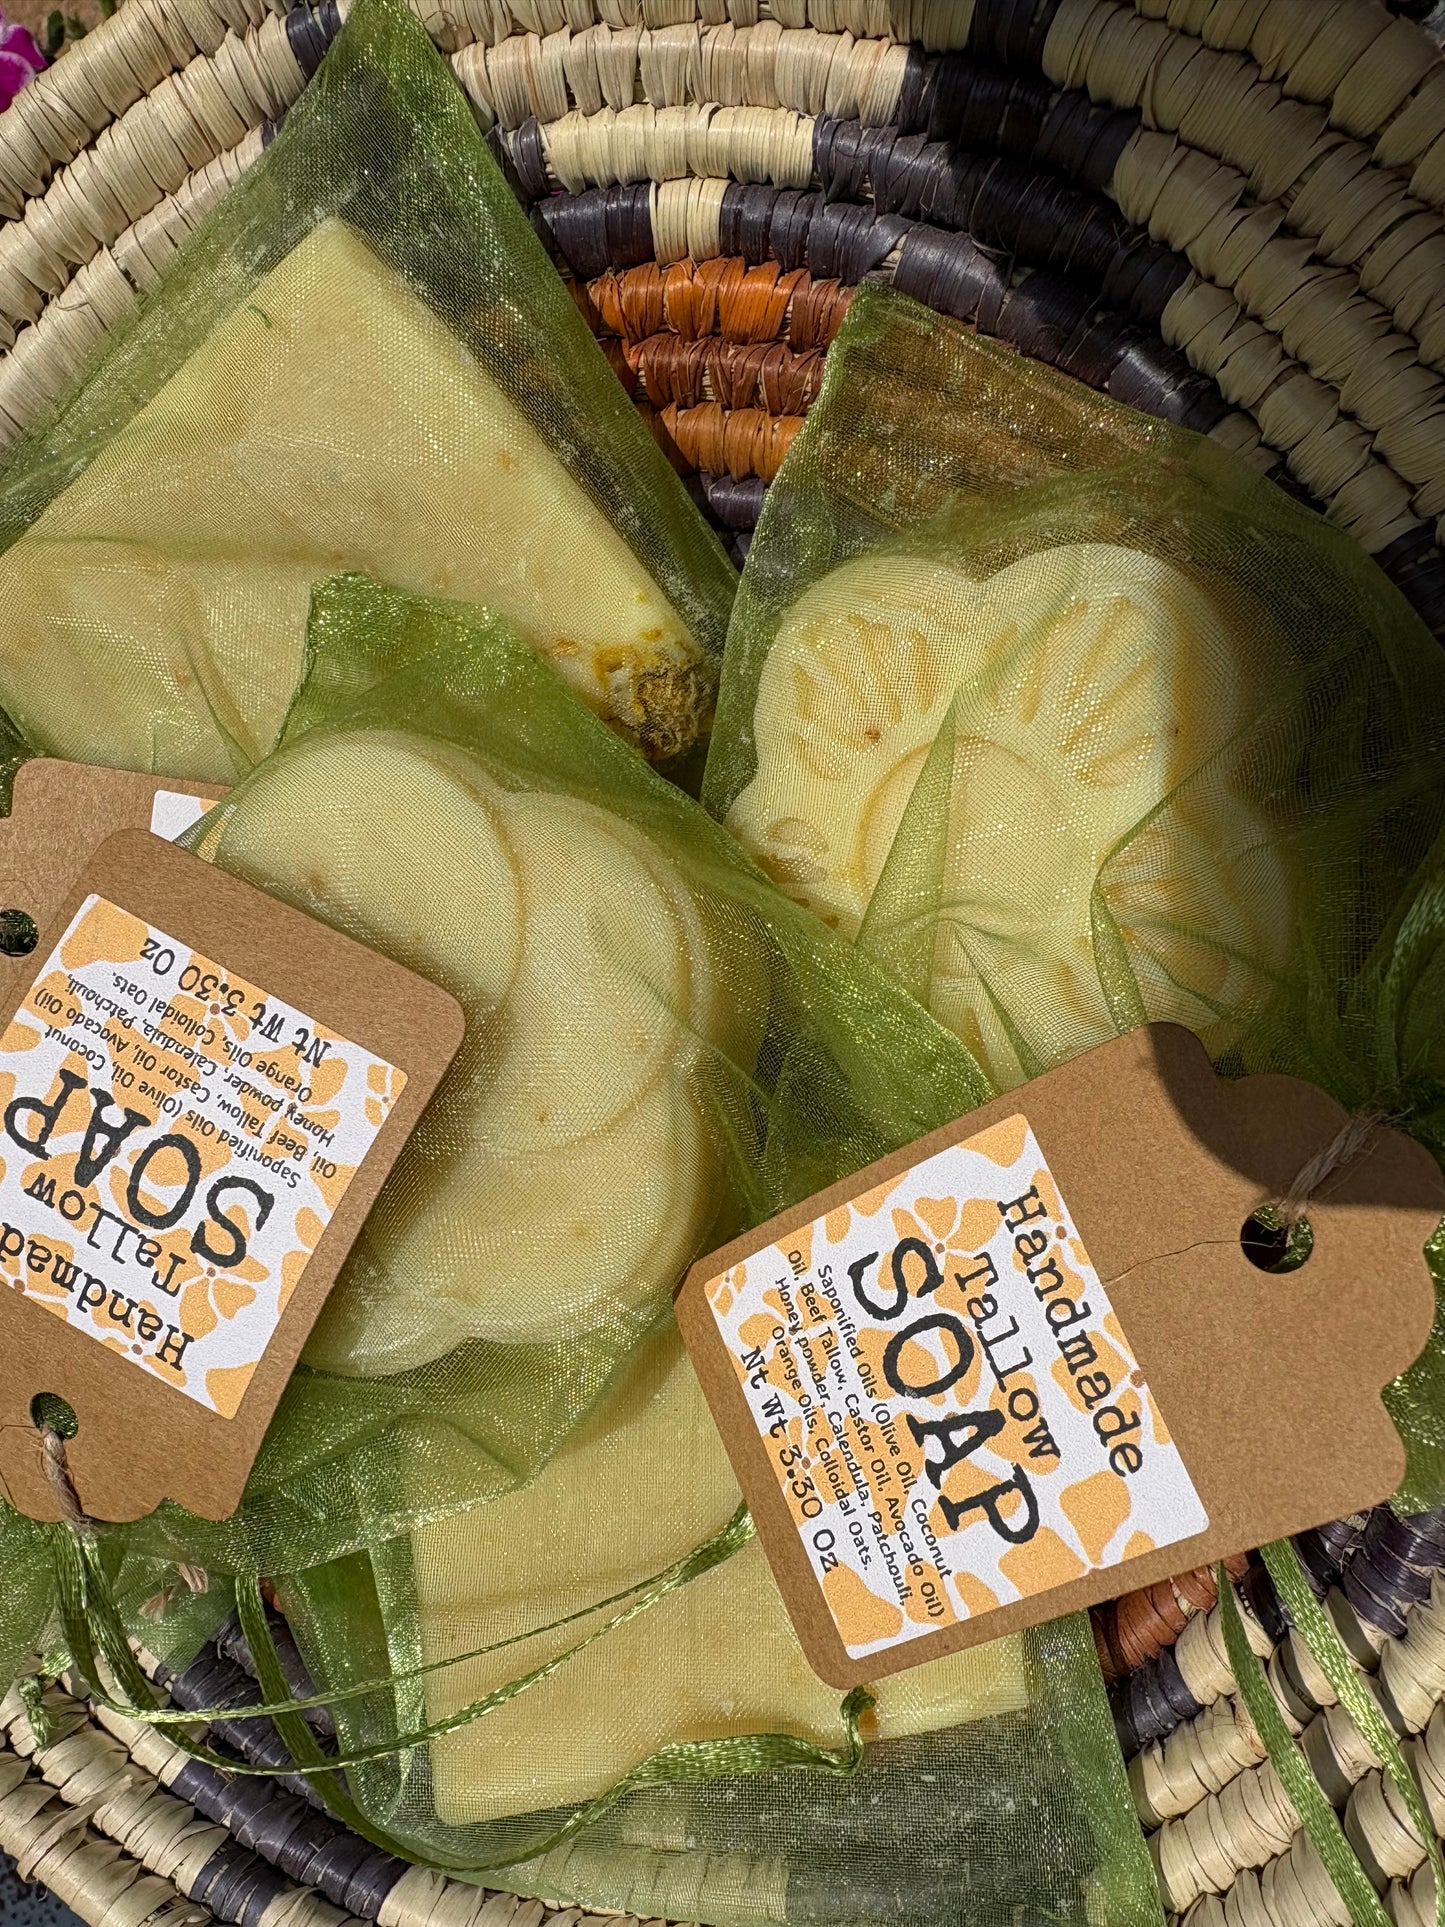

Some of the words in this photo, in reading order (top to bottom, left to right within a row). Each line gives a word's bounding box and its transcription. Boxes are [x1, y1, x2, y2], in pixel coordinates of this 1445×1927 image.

[139, 937, 176, 976] Oz
[34, 988, 64, 1015] Oil)
[64, 973, 138, 1030] Patchouli,
[112, 972, 148, 1006] Oats.
[177, 964, 245, 1017] 3.30
[66, 1007, 130, 1053] Avocado
[147, 997, 216, 1045] Colloidal
[248, 1002, 286, 1043] Wt
[44, 1024, 106, 1071] Coconut
[132, 1044, 157, 1072] Oil,
[142, 1018, 218, 1077] Calendula,
[222, 1035, 253, 1068] Oils,
[291, 1027, 332, 1069] Nt
[111, 1061, 136, 1089] Oil,
[159, 1065, 211, 1104] Castor
[223, 1067, 285, 1112] powder,
[255, 1060, 312, 1103] Orange
[138, 1081, 183, 1118] (Olive
[216, 1093, 265, 1139] Tallow,
[185, 1109, 216, 1137] Oils
[266, 1130, 308, 1162] Beef
[284, 1102, 335, 1148] Honey
[3, 1068, 275, 1269] SOAP
[216, 1129, 301, 1189] Saponified
[311, 1151, 337, 1179] Oil,
[23, 1172, 187, 1298] Tallow
[0, 1222, 195, 1372] Handmad
[996, 1185, 1144, 1478] Handmade
[953, 1251, 1062, 1459] Tallow
[846, 1236, 1040, 1545] SOAP
[775, 1276, 803, 1336] Honey
[794, 1336, 831, 1408] powder,
[827, 1411, 870, 1507] Calendula,
[867, 1511, 913, 1606] Patchouli,
[788, 1250, 807, 1281] Oil,
[800, 1282, 828, 1323] Beef
[818, 1326, 847, 1391] Tallow,
[844, 1393, 875, 1453] Castor
[870, 1458, 892, 1492] Oil,
[884, 1497, 924, 1577] Avocado
[920, 1582, 945, 1617] Oil)
[817, 1264, 865, 1359] Saponified
[856, 1363, 877, 1399] Oils
[870, 1403, 901, 1457] (Olive
[896, 1461, 918, 1495] Oil,
[911, 1498, 953, 1580] Coconut
[740, 1345, 769, 1390] Nt
[761, 1392, 789, 1439] Wt
[779, 1444, 823, 1519] 3.30
[812, 1528, 839, 1574] Oz
[772, 1326, 802, 1391] Orange
[798, 1393, 818, 1435] Oils,
[815, 1437, 857, 1517] Colloidal
[848, 1521, 872, 1571] Oats.
